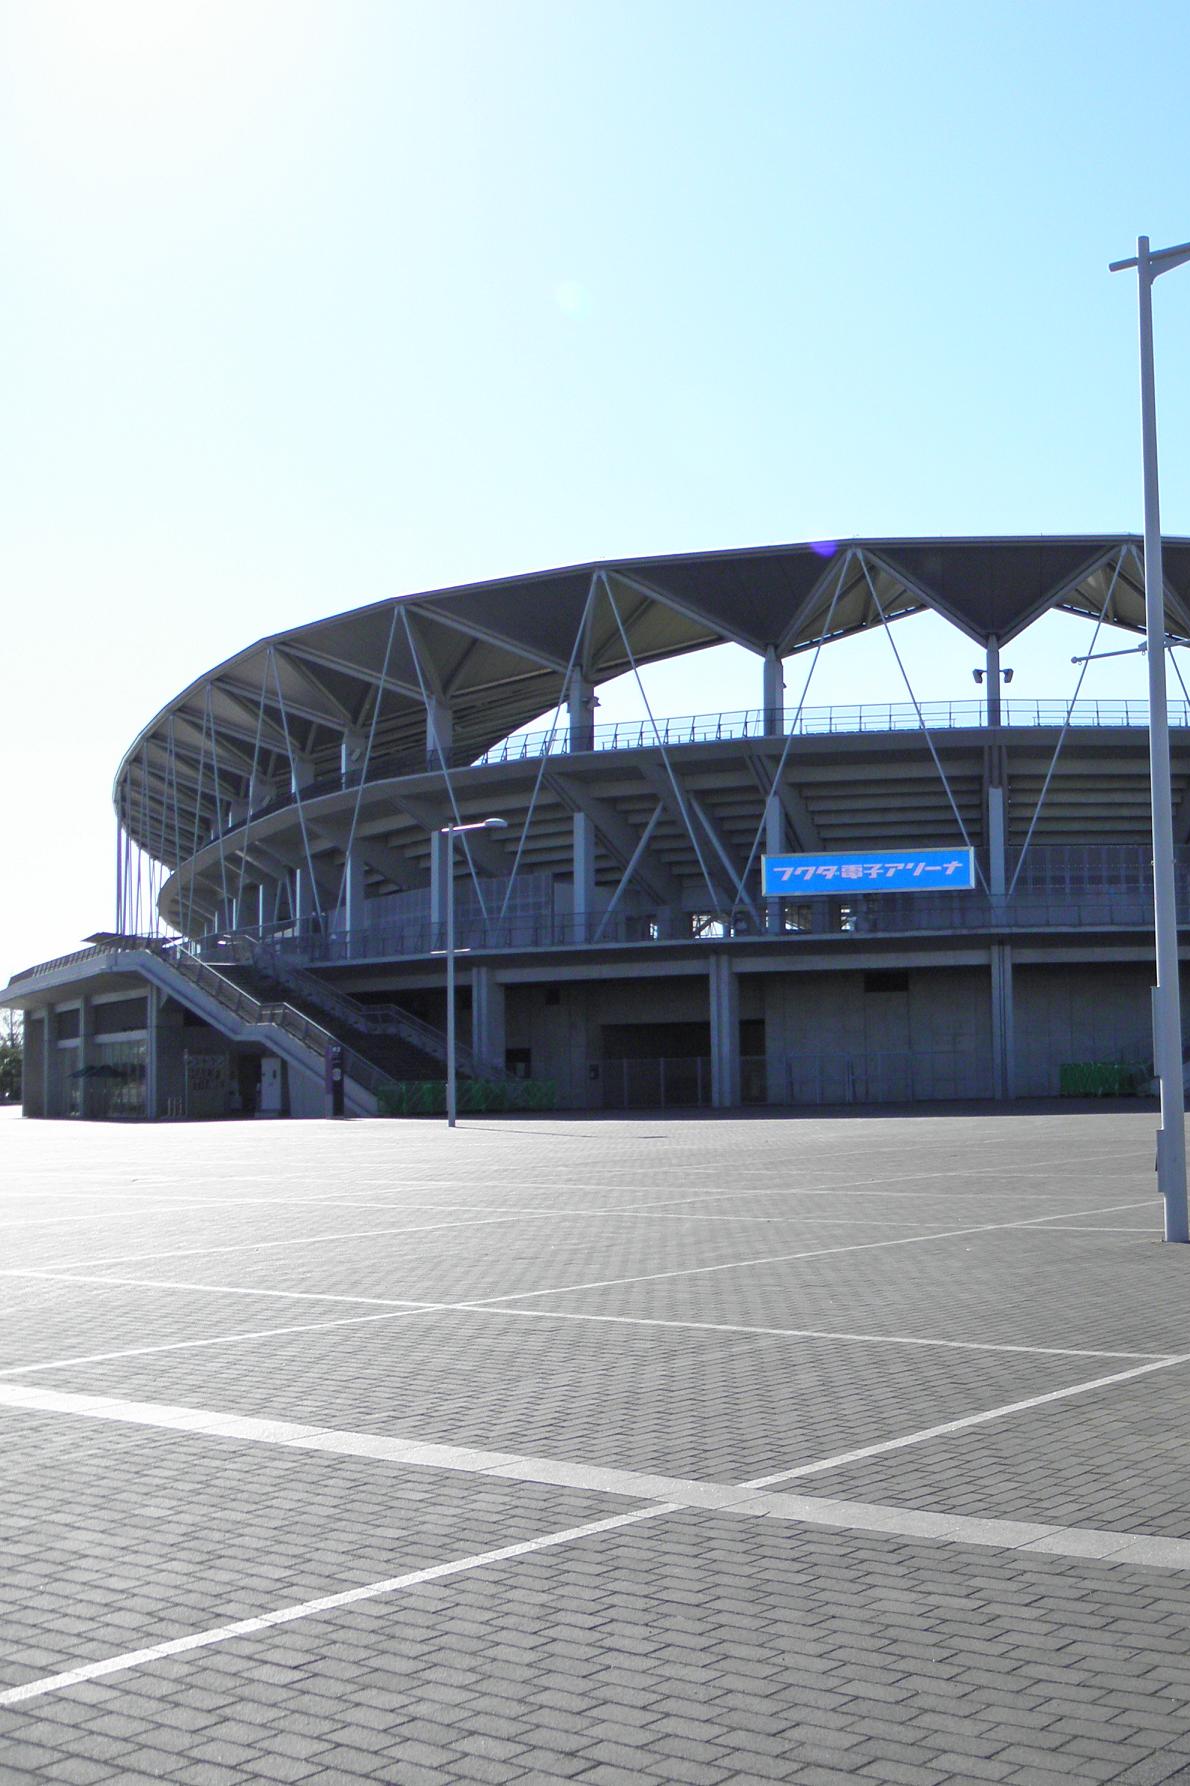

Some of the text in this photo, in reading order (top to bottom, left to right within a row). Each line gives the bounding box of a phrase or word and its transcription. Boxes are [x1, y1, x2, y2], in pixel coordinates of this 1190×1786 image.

[773, 860, 963, 881] フクダ電子アリーナ
